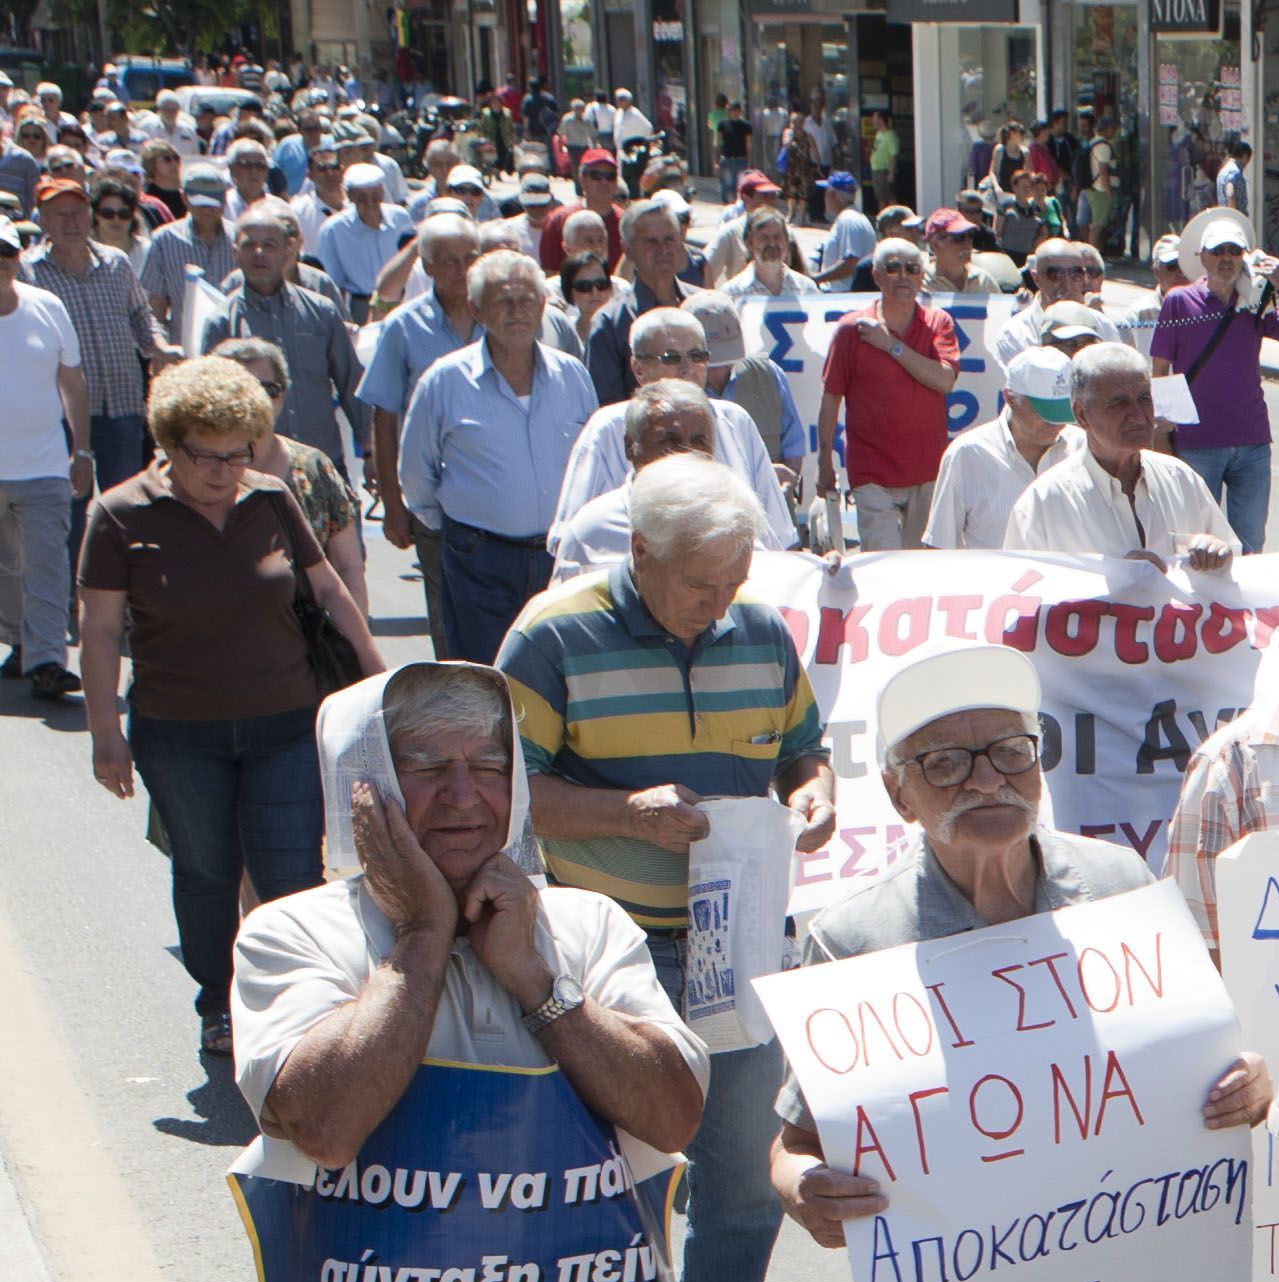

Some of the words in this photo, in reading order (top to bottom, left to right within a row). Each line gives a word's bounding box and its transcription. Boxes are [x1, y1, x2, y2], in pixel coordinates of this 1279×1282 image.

[805, 981, 976, 1076] ΟΛΟΙ
[991, 930, 1165, 1034] ΣΤΟΝ
[478, 1172, 547, 1211] να
